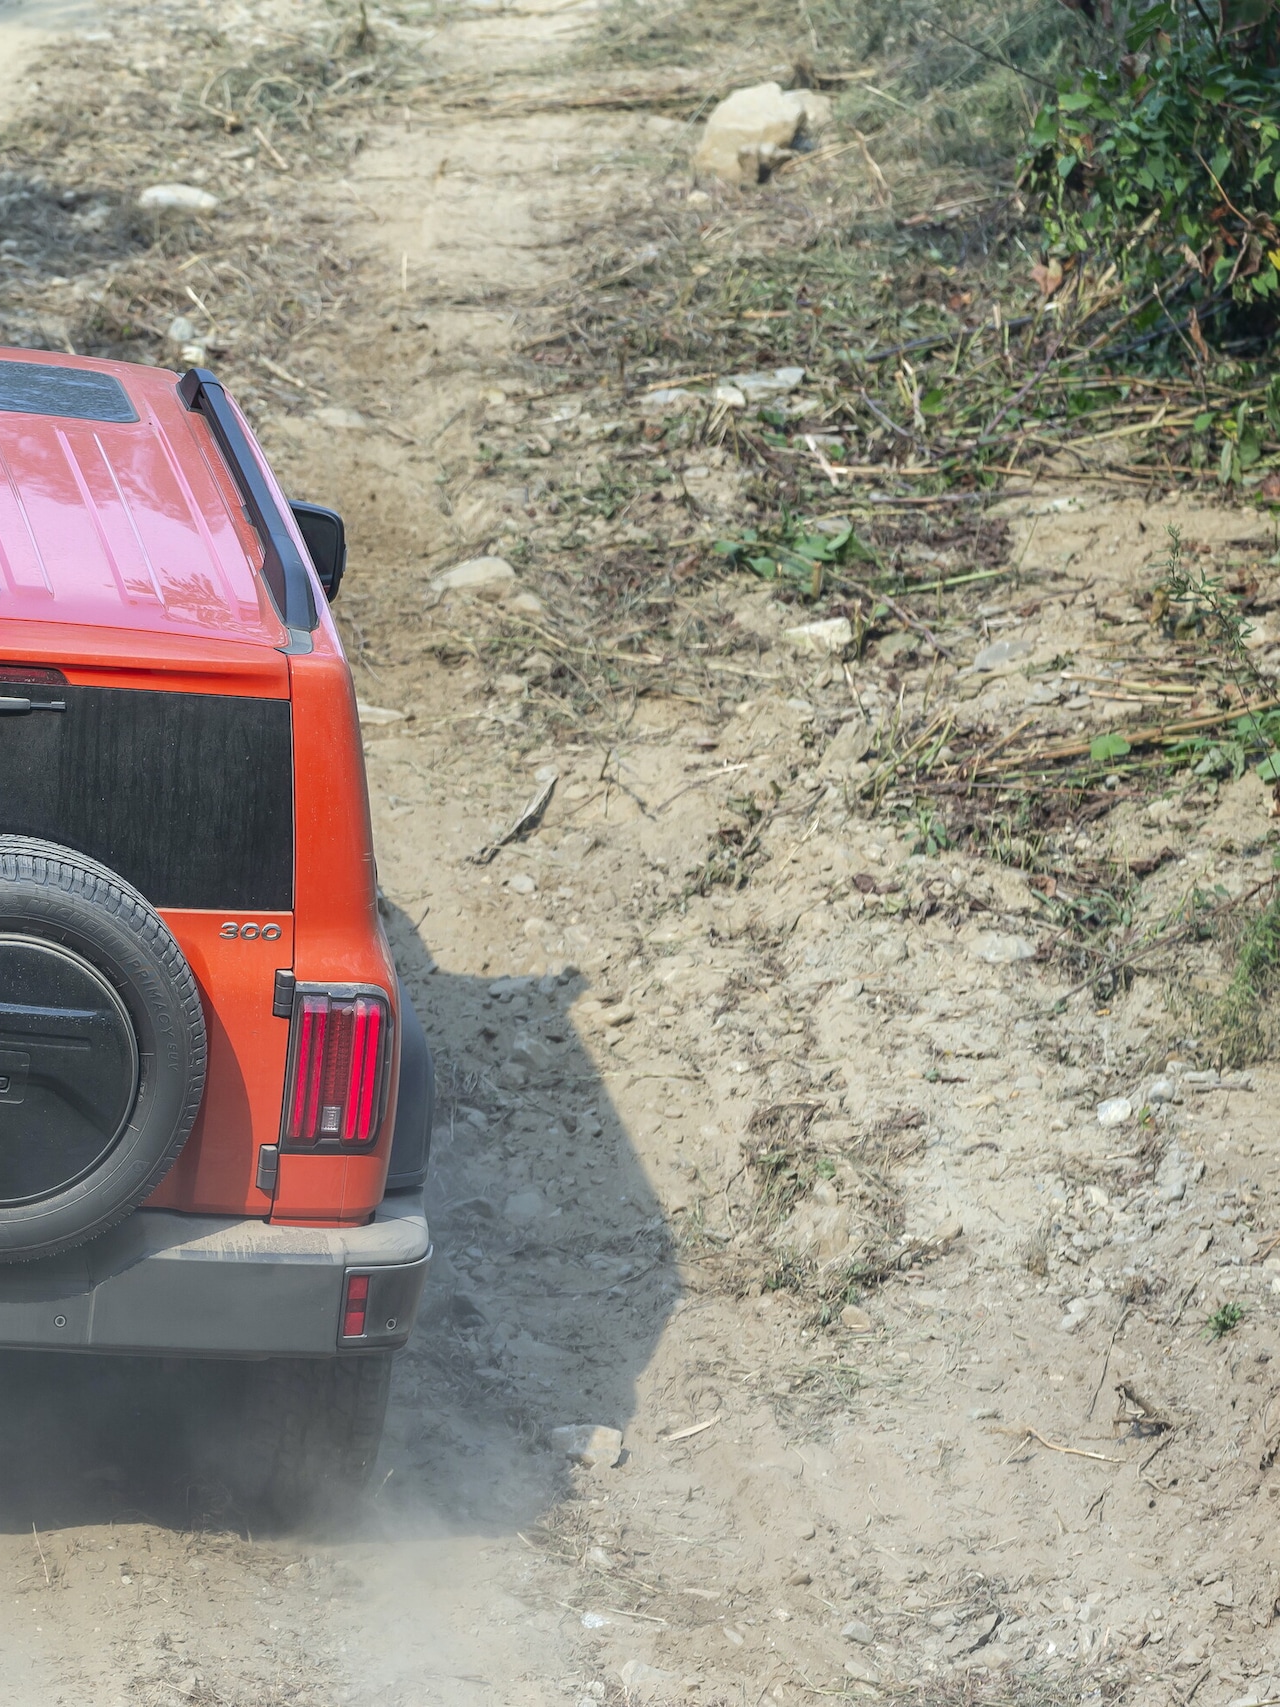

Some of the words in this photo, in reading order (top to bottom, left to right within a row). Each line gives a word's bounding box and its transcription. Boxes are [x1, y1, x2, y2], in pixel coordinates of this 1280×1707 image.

[219, 921, 282, 941] 300
[24, 899, 131, 957] MICHELIN
[128, 959, 176, 1039] PRIMACY
[166, 1042, 179, 1072] SUV
